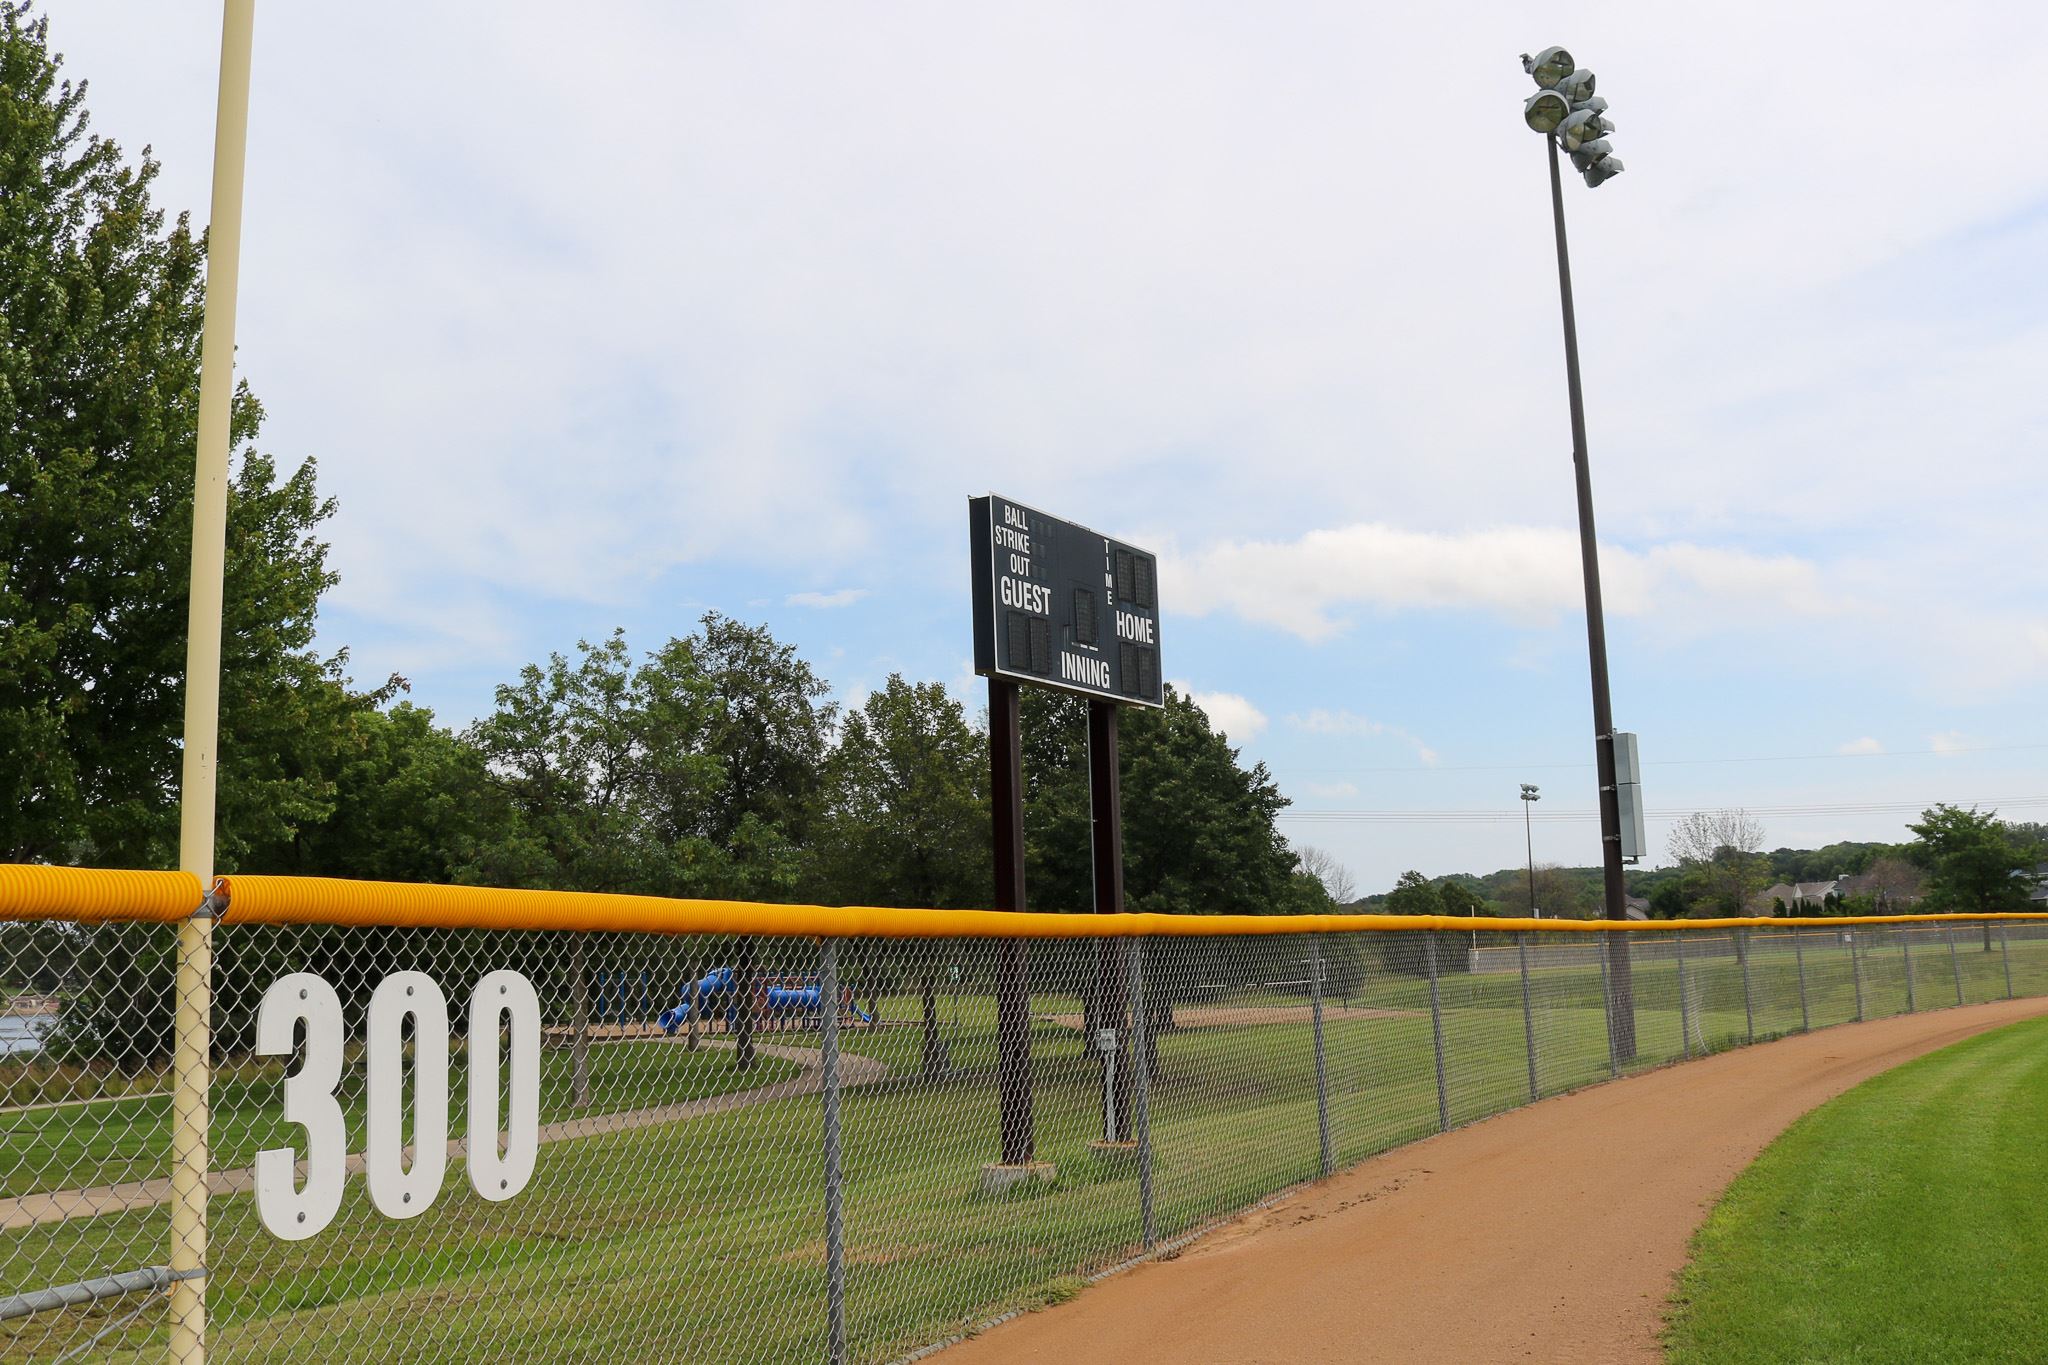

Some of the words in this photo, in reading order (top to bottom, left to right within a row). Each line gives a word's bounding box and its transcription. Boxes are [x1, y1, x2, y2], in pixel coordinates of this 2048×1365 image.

[1004, 505, 1028, 531] BALL
[995, 525, 1030, 554] STRIKE
[1010, 553, 1030, 577] OUT
[1104, 539, 1113, 605] TIME
[1000, 576, 1051, 615] GUEST
[1116, 610, 1154, 644] HOME
[1061, 651, 1110, 689] INNING
[255, 969, 541, 1241] 300
